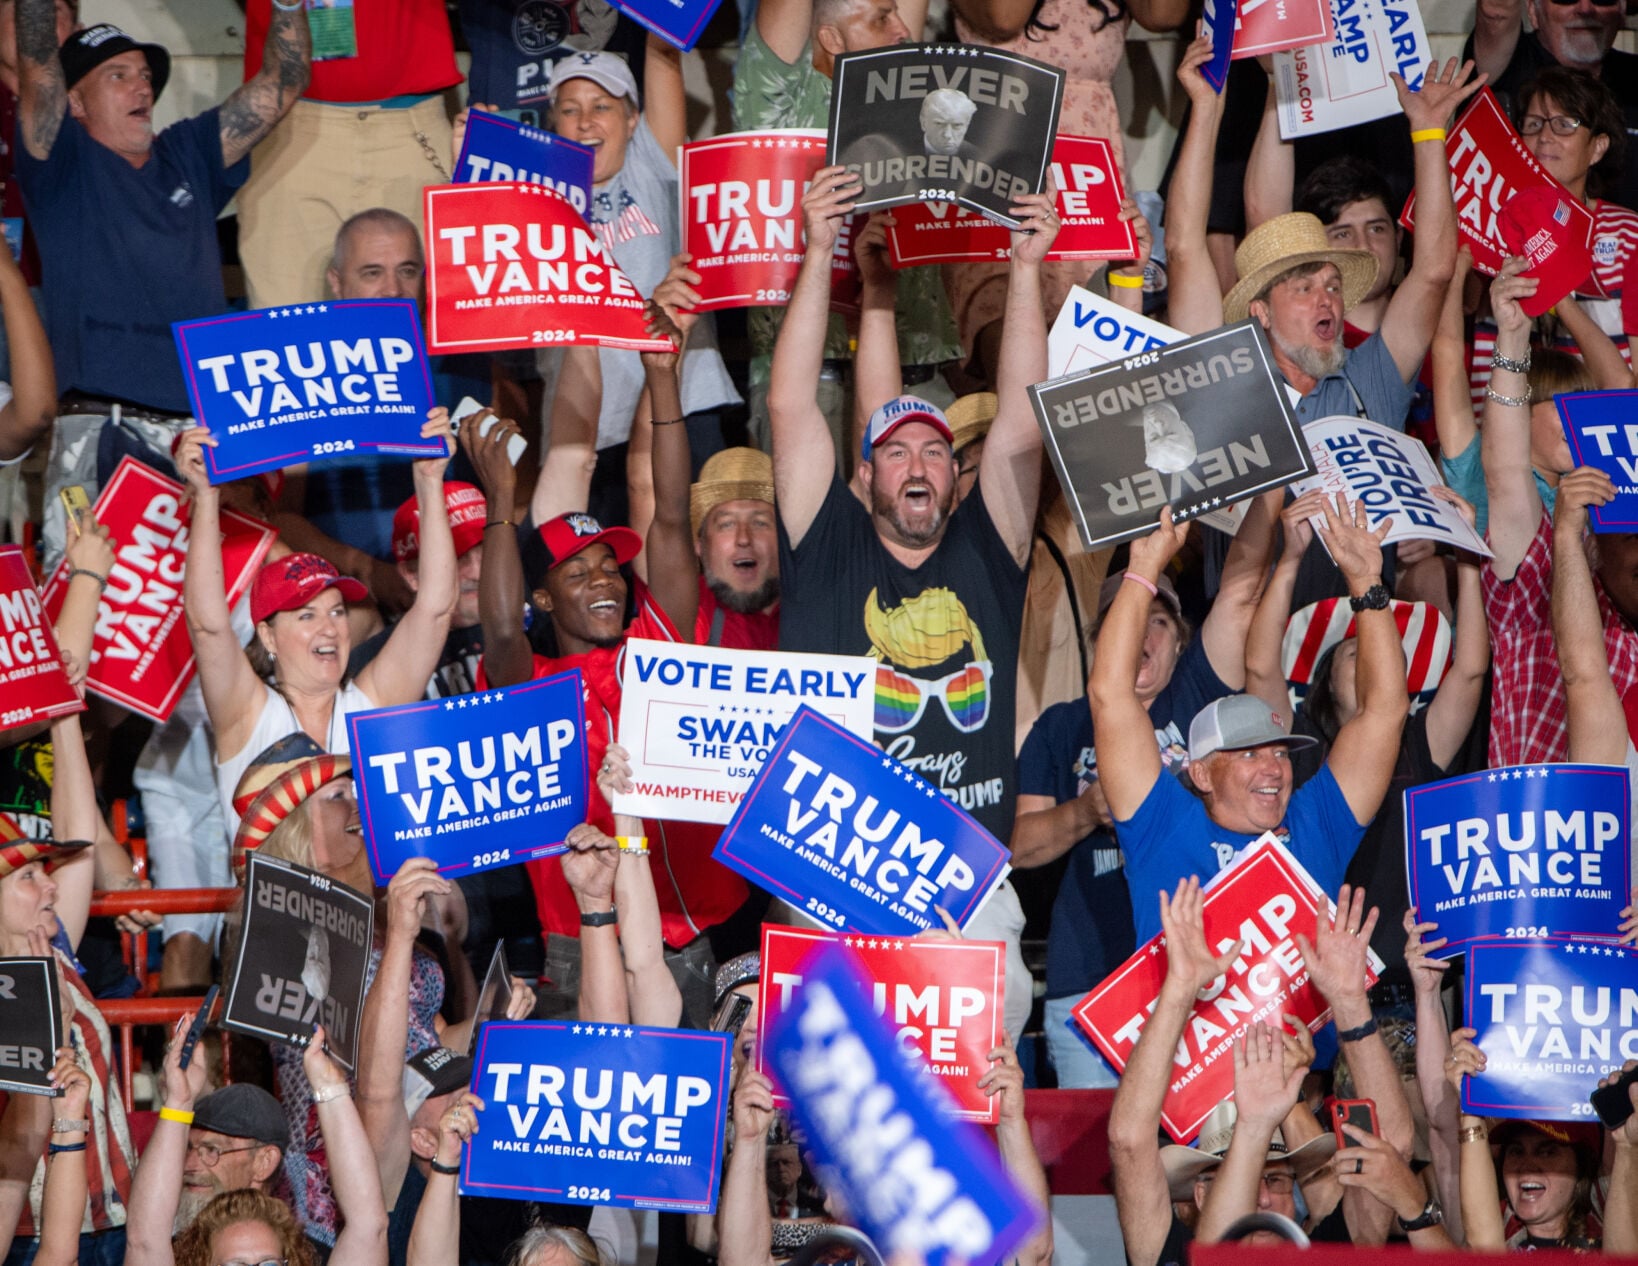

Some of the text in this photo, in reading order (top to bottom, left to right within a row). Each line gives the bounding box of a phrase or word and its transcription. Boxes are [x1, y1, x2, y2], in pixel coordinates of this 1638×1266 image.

[1336, 0, 1369, 63] AMP
[1382, 0, 1425, 92] ARLY
[865, 65, 1029, 115] NEVER
[1449, 128, 1518, 213] TRU
[691, 179, 811, 223] TRU
[918, 189, 956, 201] 2024
[1450, 172, 1507, 248] VAN
[440, 223, 615, 266] TRUM
[705, 219, 849, 256] VANE
[915, 221, 951, 231] MAKE
[955, 219, 1001, 229] AMERI
[1061, 217, 1105, 226] AGAIN!
[466, 261, 635, 296] VANCE
[697, 255, 724, 268] MAKE
[726, 253, 779, 264] AMERICA
[455, 294, 644, 310] MAKE AMERICA GREAT AGAIN
[532, 329, 576, 342] 2024
[198, 338, 414, 393] TRUMP
[1124, 352, 1160, 370] 2024
[232, 373, 402, 418] VANCE
[883, 401, 935, 418] TRUMP
[1053, 347, 1255, 428] SURRENDER
[228, 404, 416, 435] MAKE AMERICA GREAT AGAIN!
[312, 439, 355, 455] 2024
[1101, 434, 1271, 516] NEVER
[1325, 434, 1400, 524] YOU'RE
[1358, 428, 1452, 533] FIRED!
[89, 493, 182, 664] RUMP
[130, 604, 183, 682] MAKE AMERICA
[9, 665, 36, 682] GREAT
[634, 655, 867, 699] VOTE EARLY
[1, 706, 33, 725] 2024
[677, 715, 788, 747] SWAM
[369, 718, 576, 795] TRUMP
[689, 742, 771, 763] THE VO
[728, 766, 757, 778] USA
[886, 735, 968, 789] Gays
[401, 763, 561, 824] VANCE
[395, 796, 572, 841] MAKE AMERICA GREAT AGAIN!
[782, 750, 975, 891] TRUMP
[1421, 810, 1620, 866] TRUMP
[473, 849, 510, 868] 2024
[761, 824, 932, 930] MAKE AMERICA GREAT AGAIN!
[786, 798, 939, 912] VANCE
[1442, 852, 1602, 895] VANCE
[310, 874, 330, 891] 2024
[1435, 887, 1612, 912] MAKE AMERICA GREAT AGAIN!
[257, 879, 366, 948] SURRENDER
[806, 898, 847, 927] 2024
[1505, 926, 1549, 939] 2024
[1112, 894, 1296, 1044] TMP
[255, 972, 348, 1044] NEVER
[772, 972, 986, 1027] TMP
[1480, 984, 1638, 1027] TRU
[1171, 1061, 1204, 1094] MAKE
[1252, 990, 1288, 1025] GREAT
[1505, 1025, 1638, 1061] VANC
[487, 1063, 712, 1117] TRUMP
[1493, 1062, 1530, 1072] MAKE
[1539, 1063, 1595, 1074] AMERICA
[507, 1104, 683, 1151] VANCE
[1571, 1103, 1595, 1115] 20
[493, 1139, 692, 1166] MAKE AMERICA GREAT AGAIN!
[567, 1185, 611, 1201] 2024
